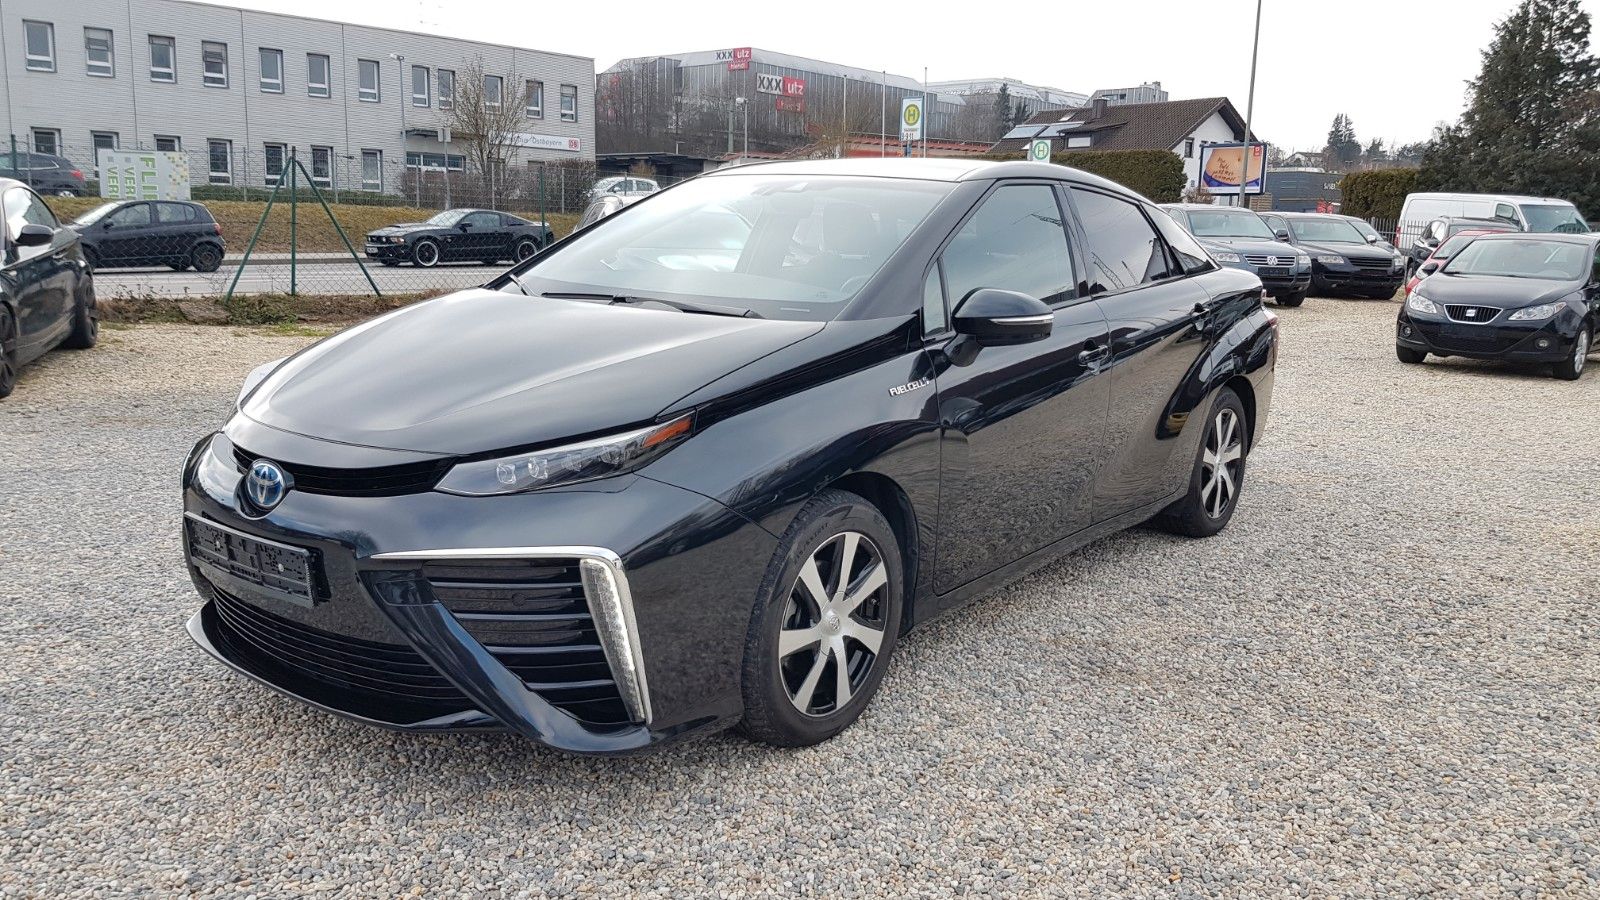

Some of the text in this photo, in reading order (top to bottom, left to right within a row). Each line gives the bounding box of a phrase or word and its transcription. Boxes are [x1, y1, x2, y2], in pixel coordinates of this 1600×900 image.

[758, 76, 782, 92] XXX
[907, 109, 916, 121] H
[1037, 145, 1045, 156] H
